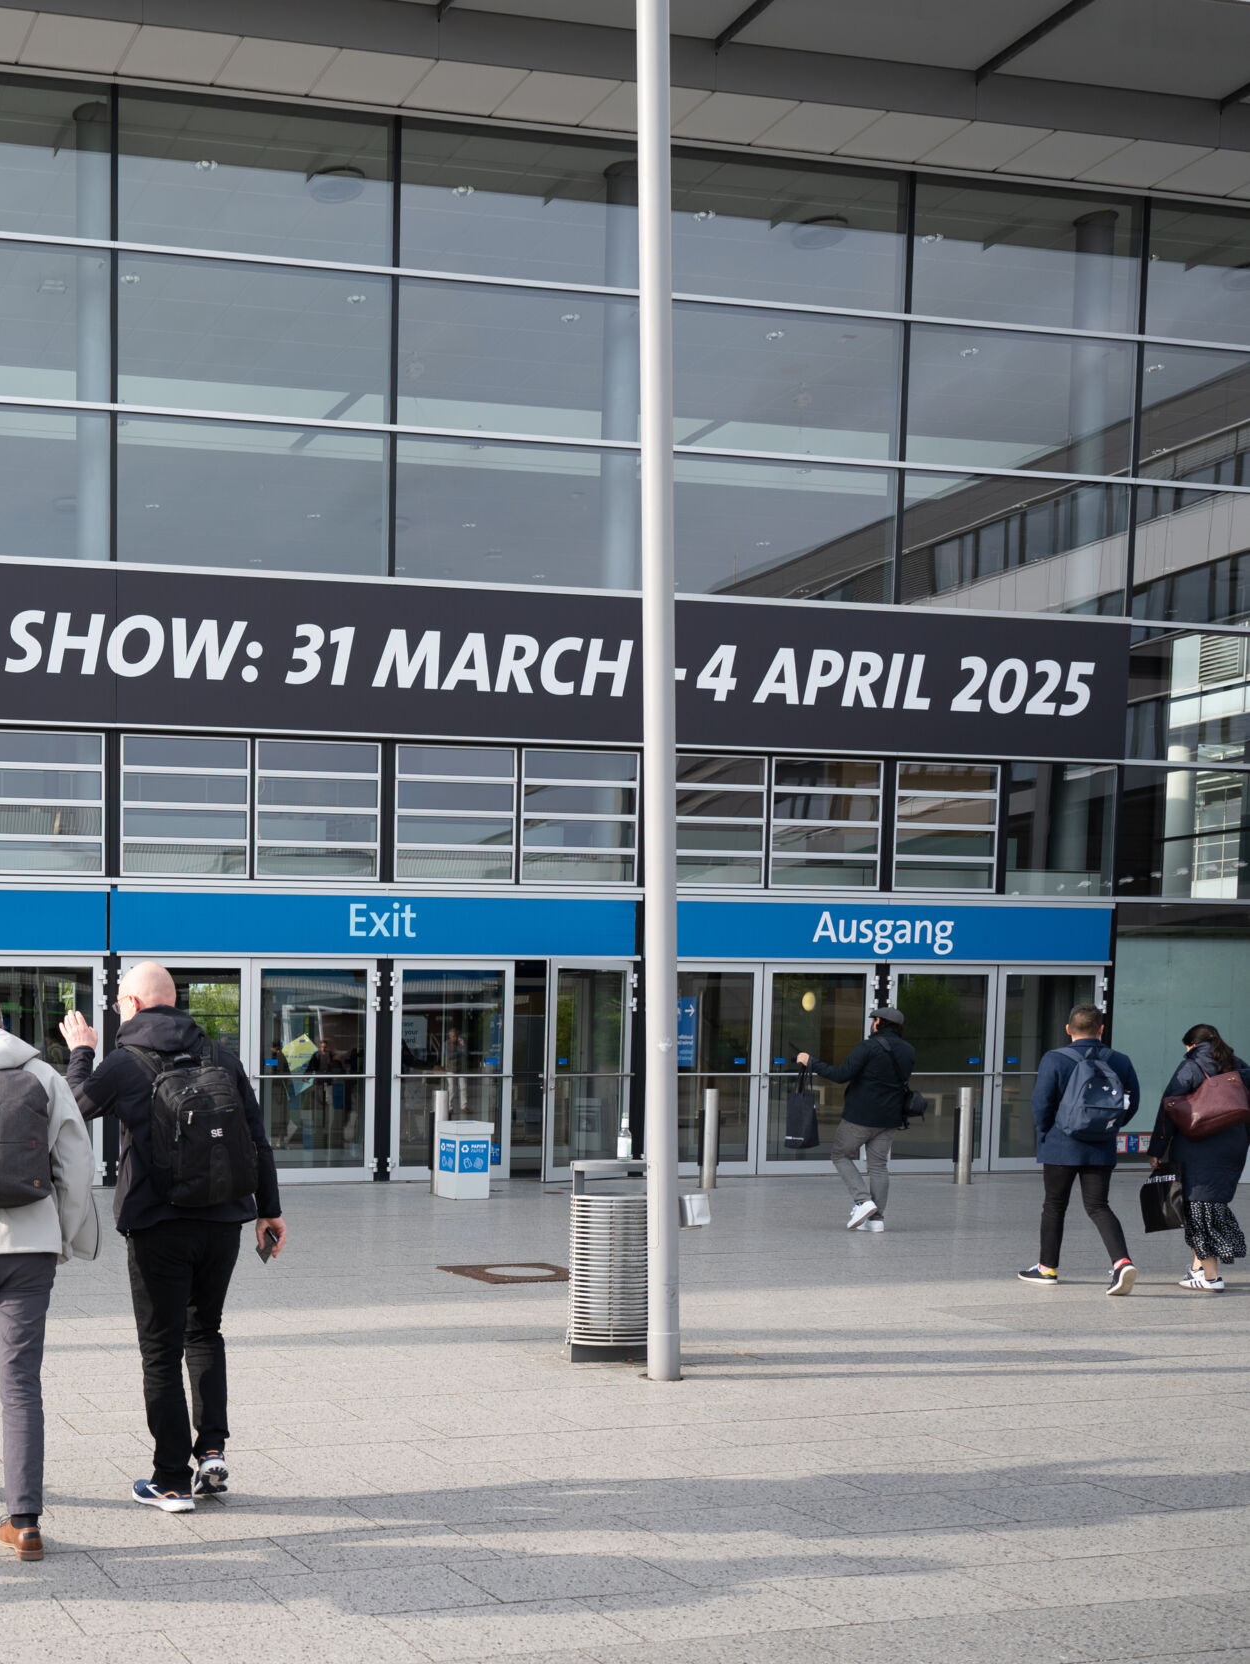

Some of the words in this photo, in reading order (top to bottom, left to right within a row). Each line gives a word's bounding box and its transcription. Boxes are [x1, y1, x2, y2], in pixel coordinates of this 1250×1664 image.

[4, 610, 264, 683] SHOW:
[284, 624, 356, 686] 31
[371, 629, 634, 698] MARCH
[696, 644, 738, 702] 4
[752, 647, 931, 710] APRIL
[950, 657, 1096, 717] 2025
[349, 902, 417, 938] Exit
[812, 910, 956, 956] Ausgang
[211, 1128, 223, 1138] SE
